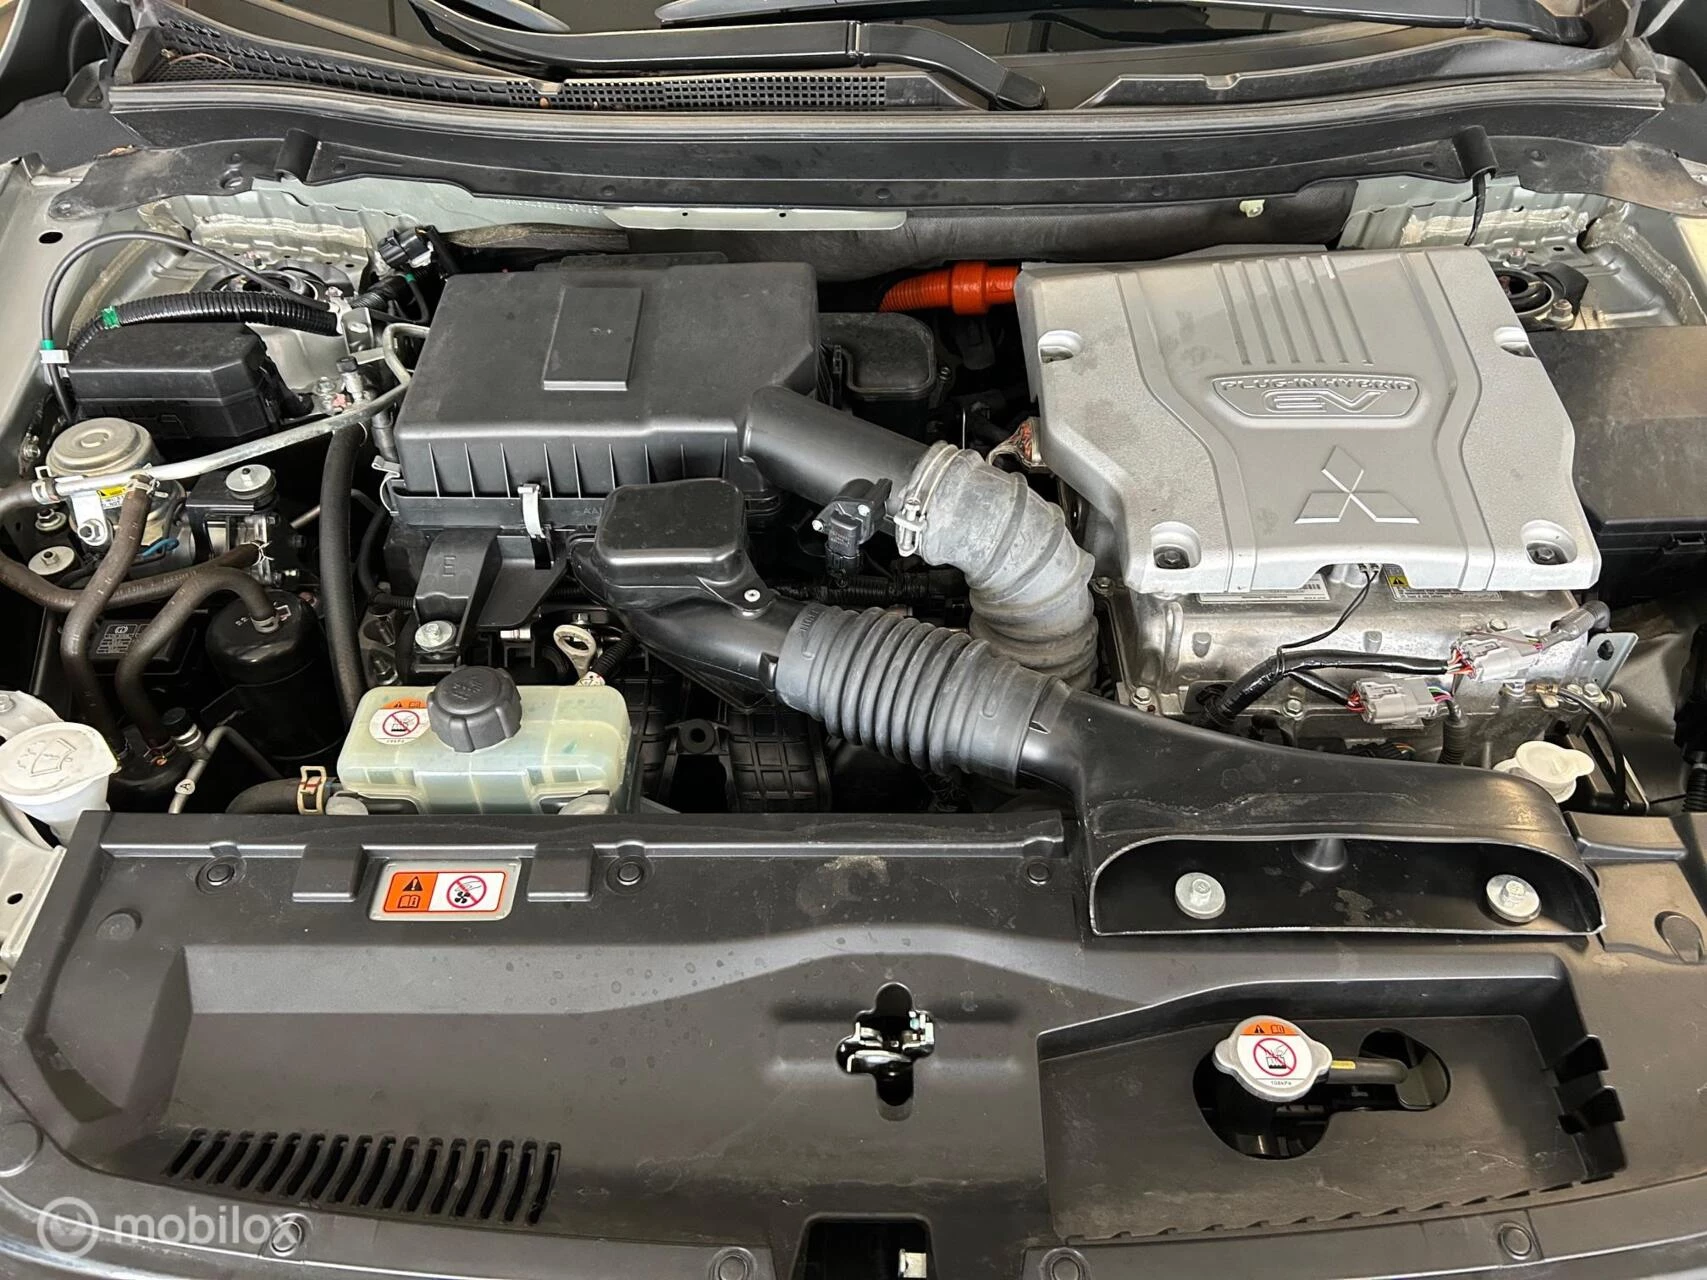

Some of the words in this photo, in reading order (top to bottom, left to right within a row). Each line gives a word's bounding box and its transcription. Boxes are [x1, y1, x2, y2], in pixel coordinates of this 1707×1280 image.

[1221, 377, 1316, 391] PLUG-IN
[1323, 377, 1413, 391] HYBRID
[1264, 388, 1388, 413] EV
